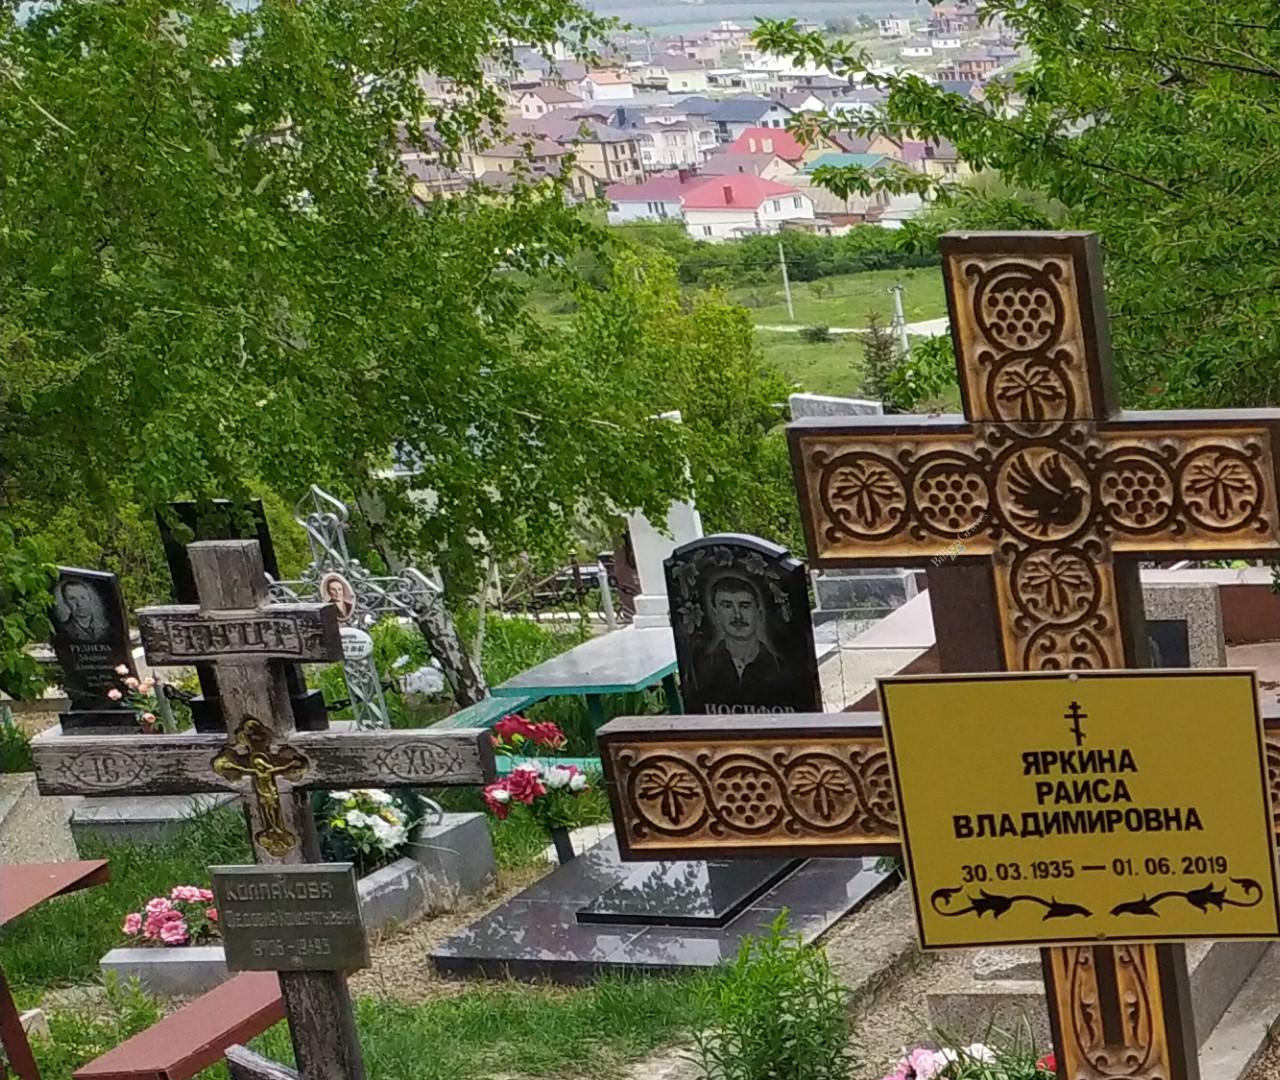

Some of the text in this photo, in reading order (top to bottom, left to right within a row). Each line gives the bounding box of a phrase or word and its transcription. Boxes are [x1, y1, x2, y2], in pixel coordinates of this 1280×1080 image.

[1022, 748, 1138, 776] ЯРКИНА
[1036, 778, 1132, 805] РАИСА
[952, 807, 1204, 839] ВЛАДИМИРОВНА
